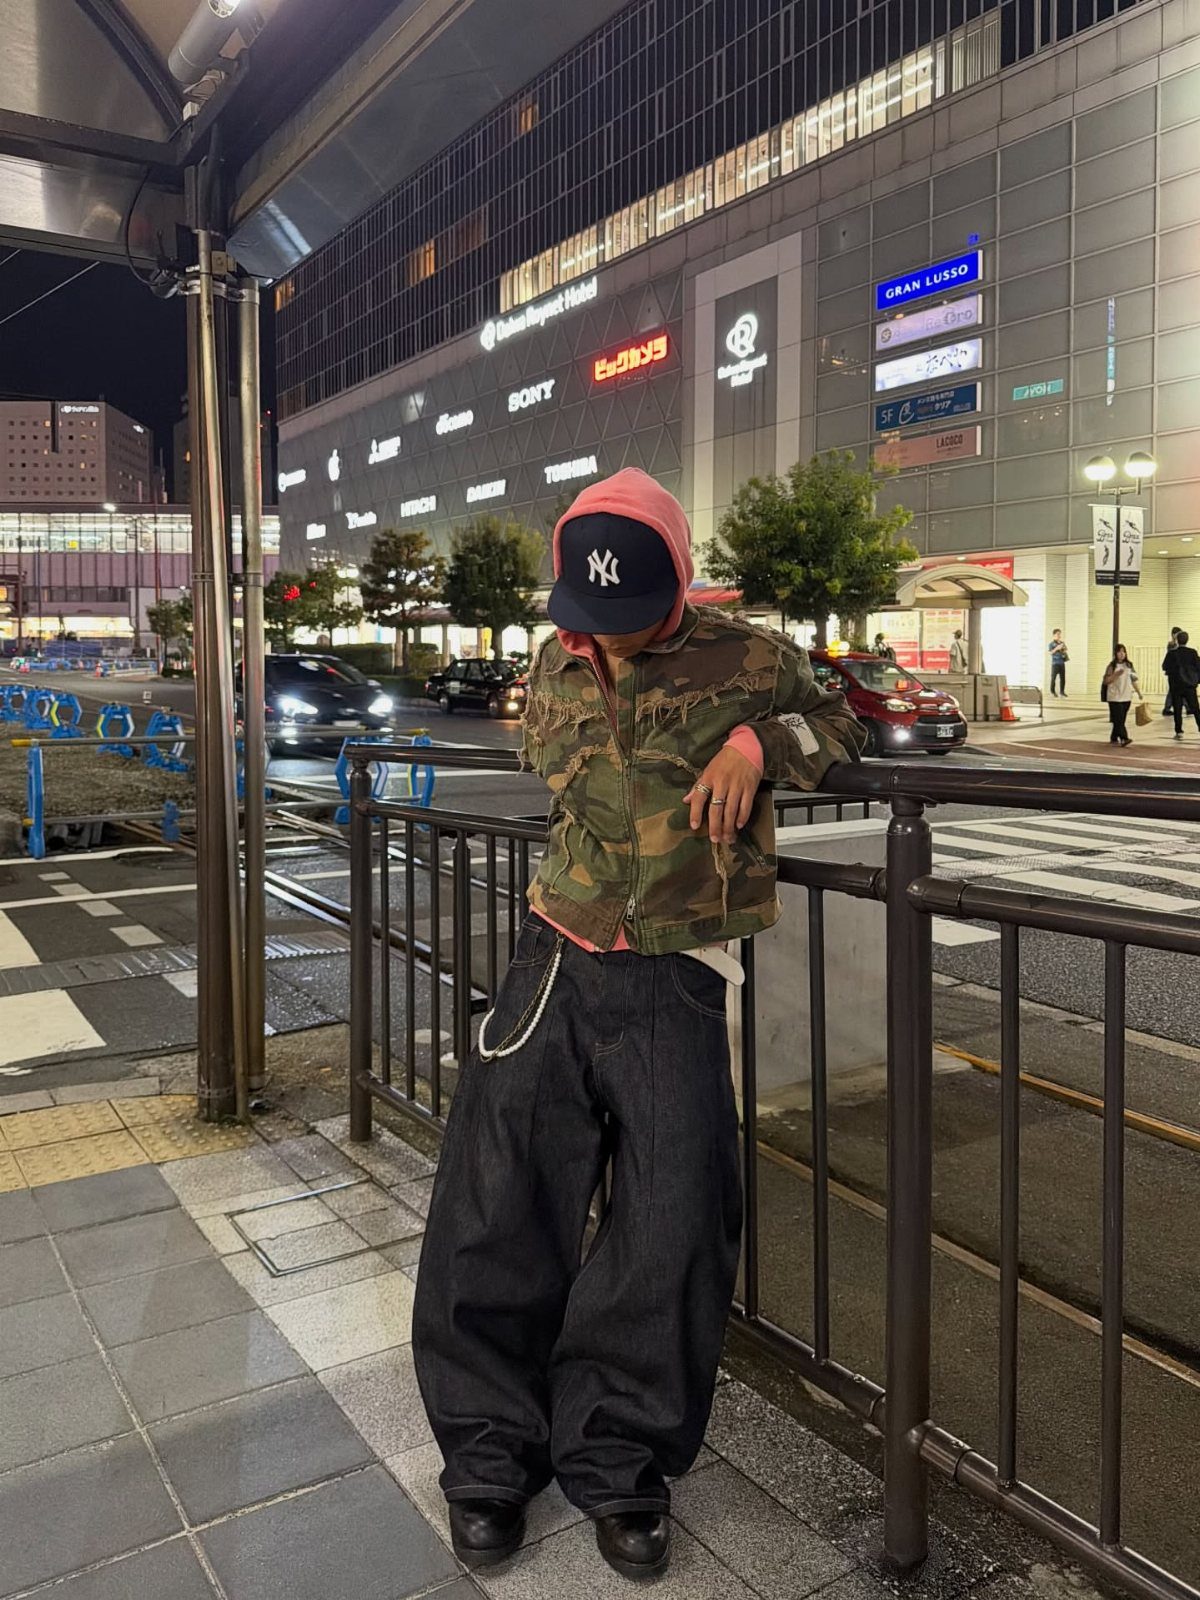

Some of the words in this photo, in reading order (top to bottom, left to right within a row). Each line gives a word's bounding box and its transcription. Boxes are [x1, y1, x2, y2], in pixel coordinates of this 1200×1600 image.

[564, 275, 598, 311] Hotel
[885, 279, 921, 299] GRAN
[925, 264, 969, 287] LUSSO
[593, 334, 668, 382] ビックカメラ
[508, 378, 556, 412] SONY
[544, 455, 598, 484] TOSHIBA
[400, 495, 436, 518] HITACHI
[466, 479, 506, 503] DAIKIN
[587, 548, 621, 587] NY
